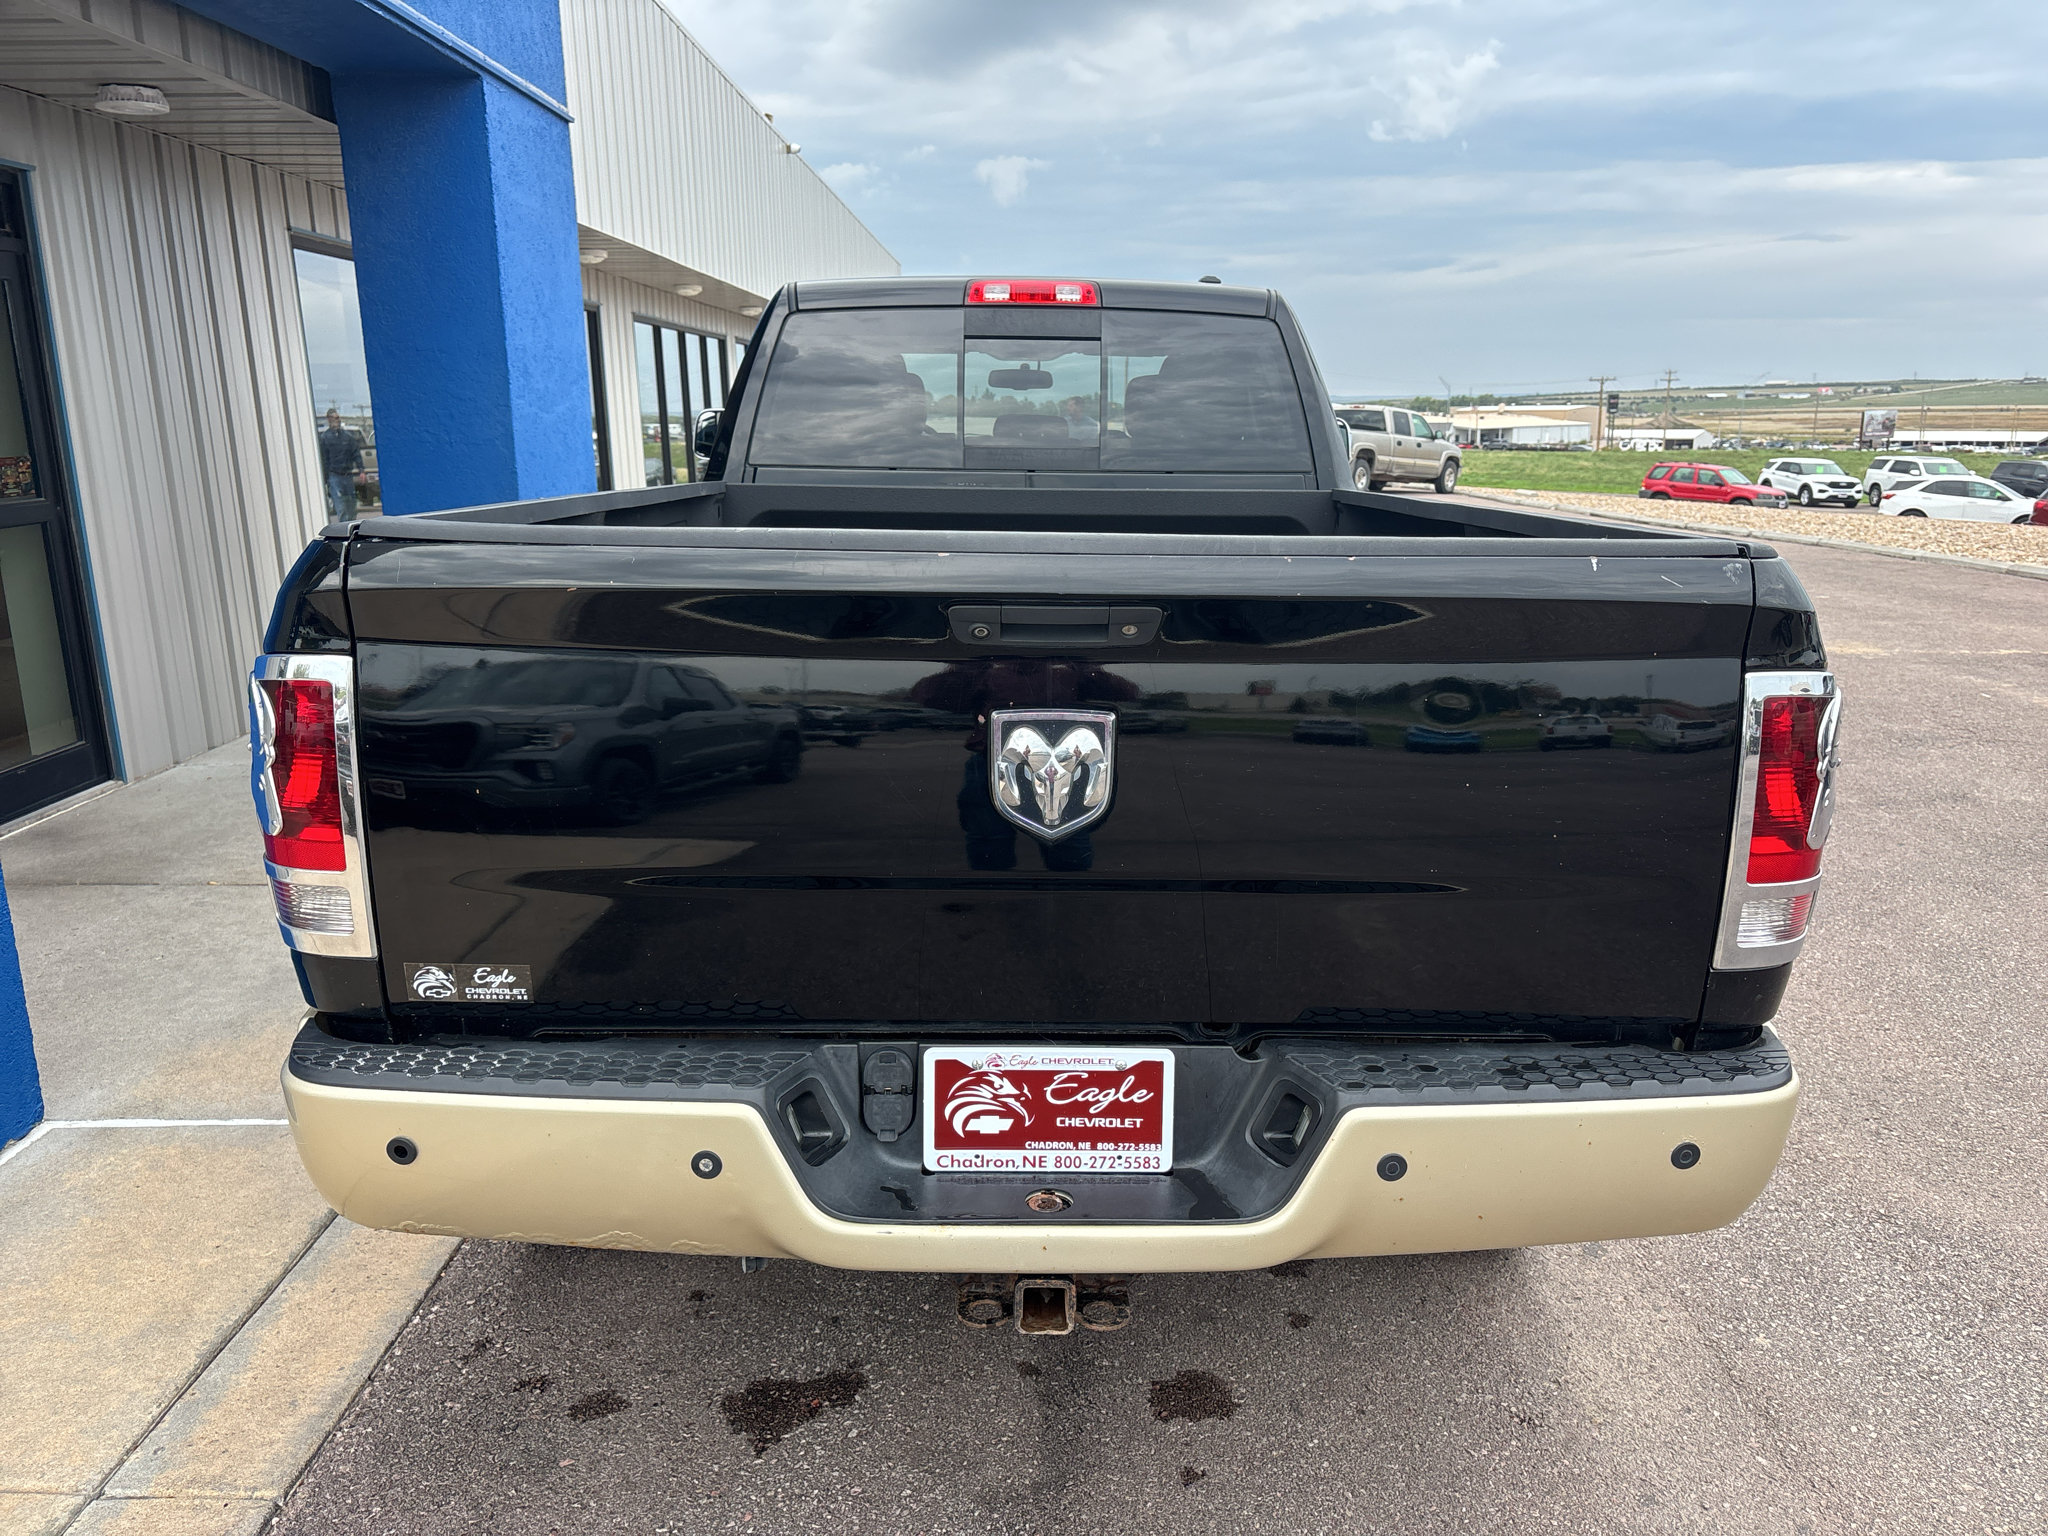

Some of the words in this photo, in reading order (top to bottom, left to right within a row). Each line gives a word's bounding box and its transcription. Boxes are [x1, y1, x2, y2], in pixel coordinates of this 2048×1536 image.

[473, 967, 516, 987] Eagle
[1009, 1054, 1039, 1069] Eagle
[1044, 1072, 1154, 1114] Eagle
[1056, 1117, 1144, 1128] CHEVROLET
[1025, 1141, 1076, 1150] CHADRON,
[1078, 1142, 1091, 1150] NE
[1097, 1143, 1162, 1151] 800-272-5583
[937, 1155, 1021, 1169] Chadron,
[1023, 1156, 1047, 1168] NE
[1054, 1156, 1160, 1169] 800-272-5583
